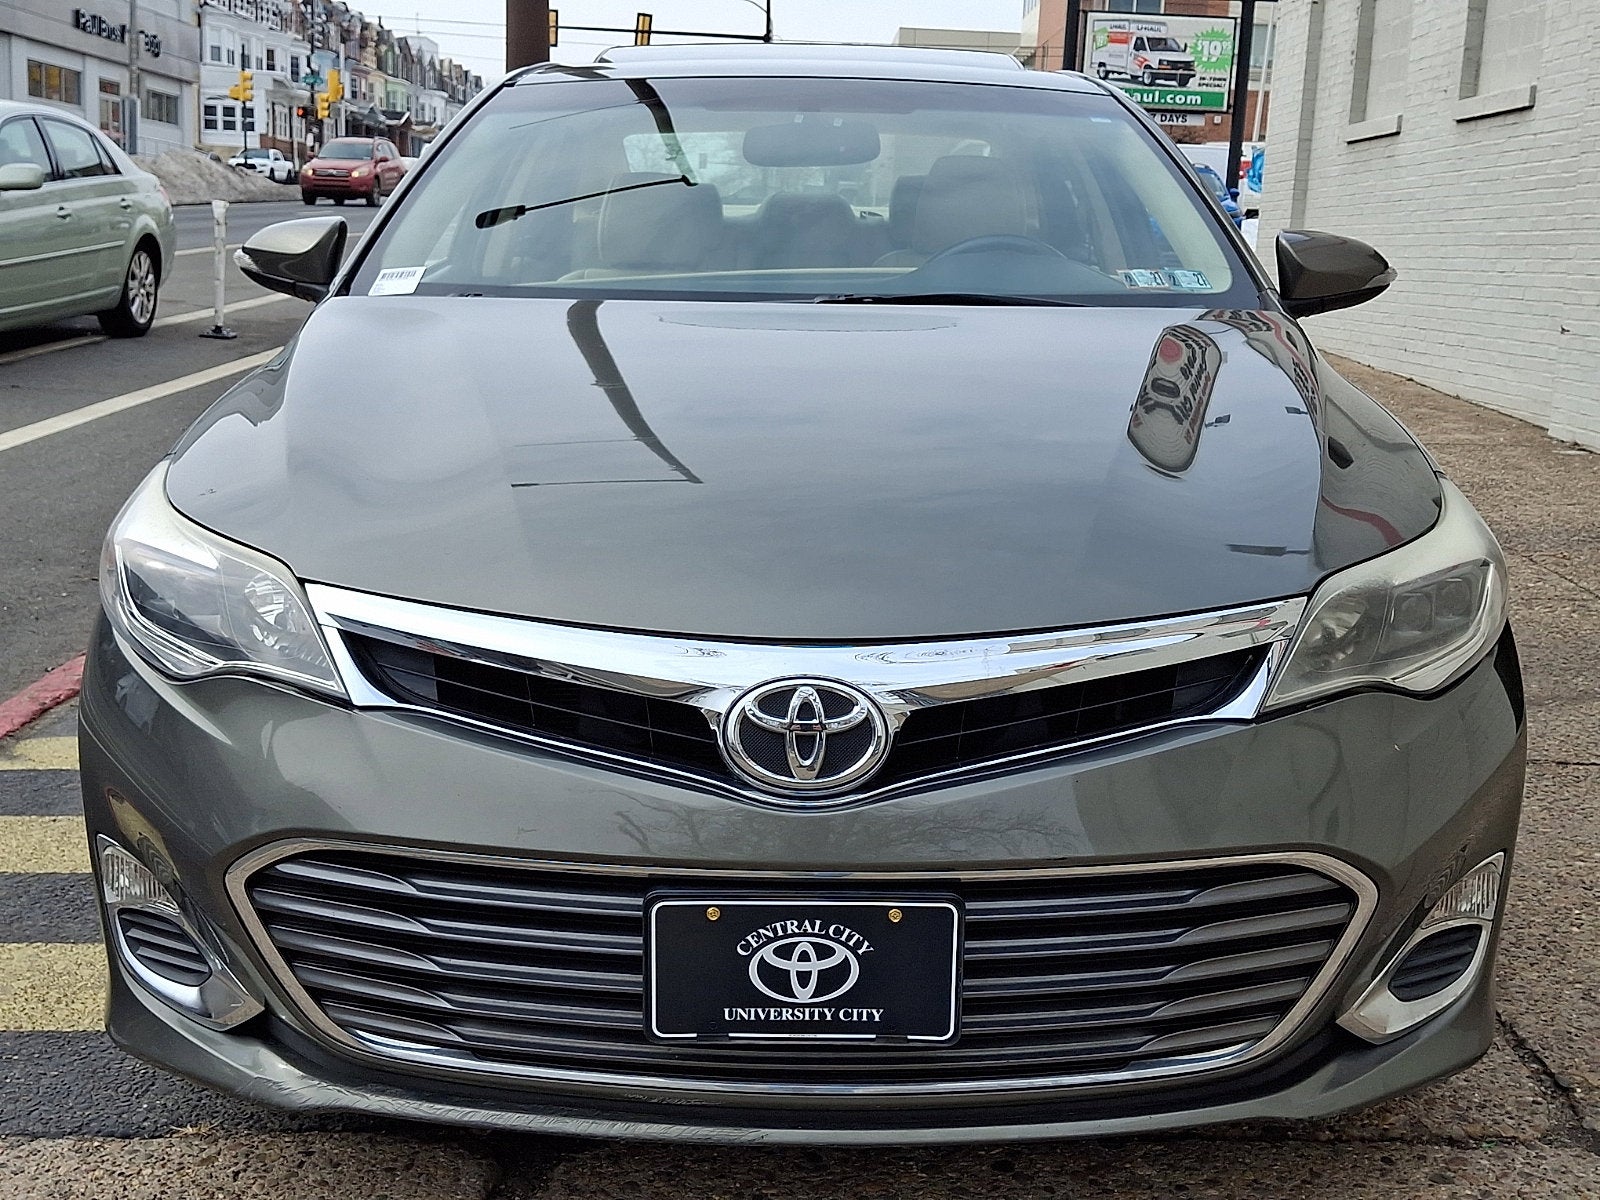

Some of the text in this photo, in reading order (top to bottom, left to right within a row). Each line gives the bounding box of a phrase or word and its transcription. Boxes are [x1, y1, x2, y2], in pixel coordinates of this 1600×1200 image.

[1159, 113, 1188, 123] DAYS
[736, 919, 875, 956] CENTRAL CITY
[723, 1007, 884, 1022] UNIVERSITY CITY
